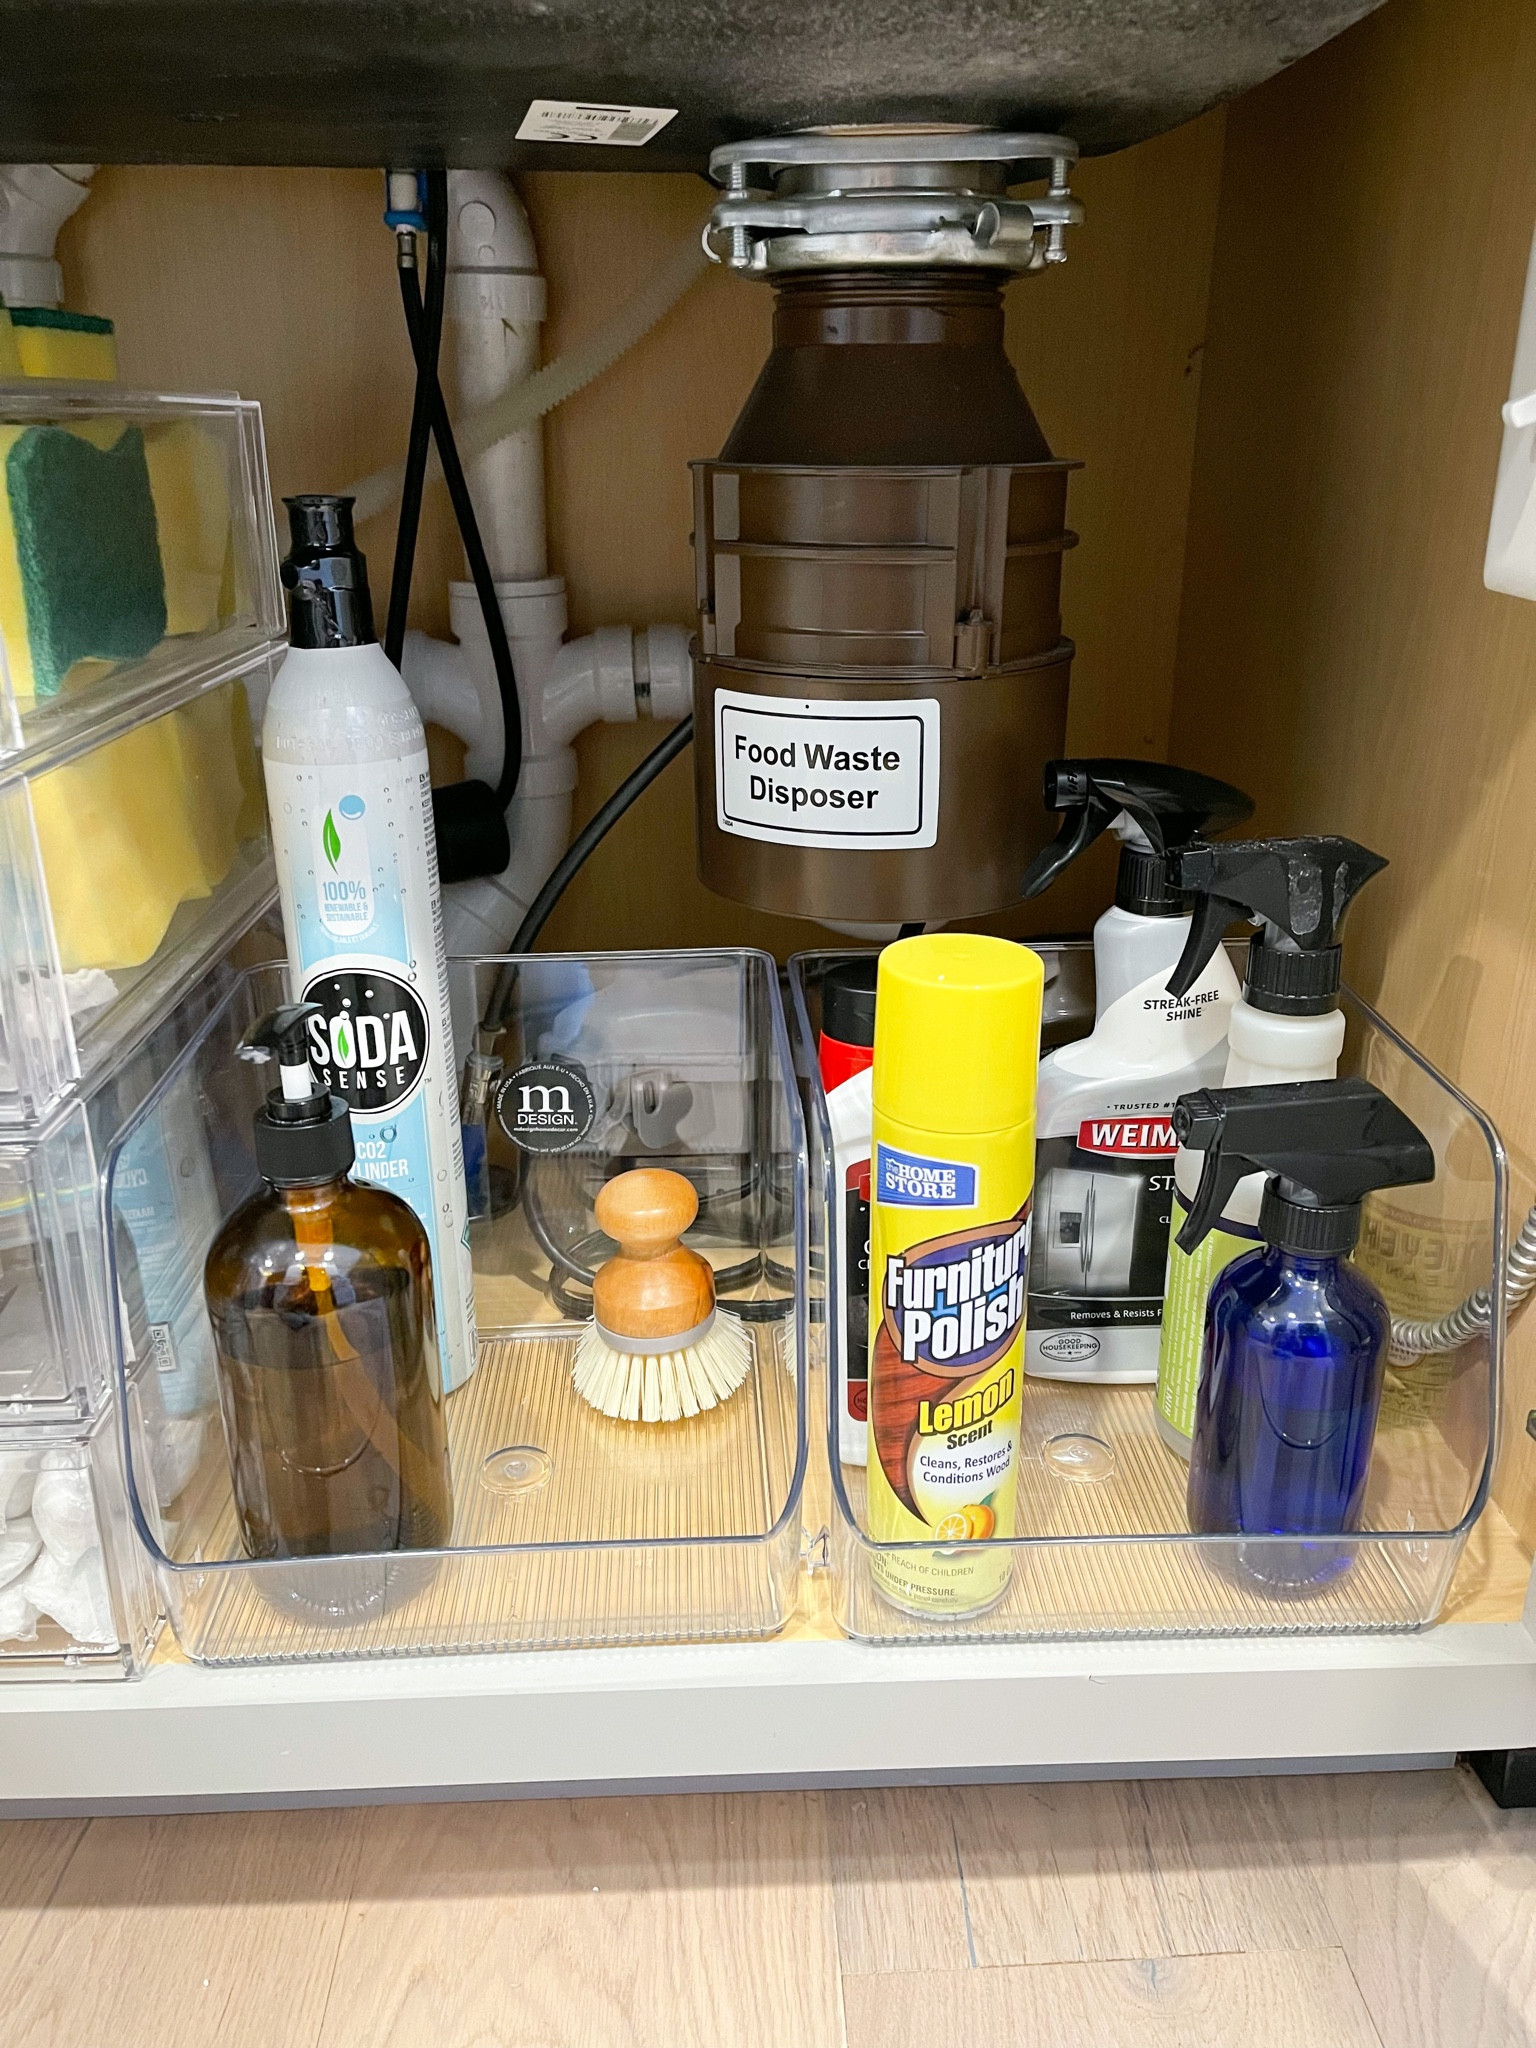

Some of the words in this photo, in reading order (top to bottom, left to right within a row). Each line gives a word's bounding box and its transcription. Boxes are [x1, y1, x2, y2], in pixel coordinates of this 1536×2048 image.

[735, 734, 796, 768] Food
[803, 743, 901, 771] Waste
[750, 775, 879, 812] Disposer
[323, 880, 366, 901] 100%
[324, 902, 362, 912] RENEWABLE
[326, 912, 368, 922] SUSTAINABLE
[1143, 990, 1219, 1010] STREAK-FREE
[1166, 1007, 1202, 1022] SHINE
[307, 1009, 418, 1069] SODA
[322, 1066, 406, 1089] SENSE
[518, 1085, 574, 1113] m
[1114, 1102, 1159, 1110] TRUSTED
[1092, 1123, 1180, 1147] WEIM
[356, 1141, 387, 1160] CO2
[350, 1158, 409, 1180] YLINDER
[885, 1157, 899, 1174] the
[898, 1163, 956, 1183] HOME
[885, 1173, 956, 1199] STORE
[903, 1273, 1024, 1362] Polish
[1070, 1306, 1111, 1320] Removes
[1114, 1305, 1121, 1318] &
[1123, 1304, 1155, 1318] Resists
[1042, 1343, 1098, 1351] HOUSEKEEPING
[918, 1368, 1016, 1436] Lemon
[947, 1419, 993, 1450] Scent
[920, 1455, 961, 1471] Cleans,
[964, 1447, 1006, 1469] Restores
[1006, 1440, 1013, 1453] &
[923, 1471, 984, 1484] Conditions
[986, 1455, 1011, 1478] Wood
[891, 1553, 917, 1572] REACH
[918, 1565, 930, 1575] OF
[931, 1566, 975, 1577] CHILDREN
[885, 1570, 909, 1588] UNDER
